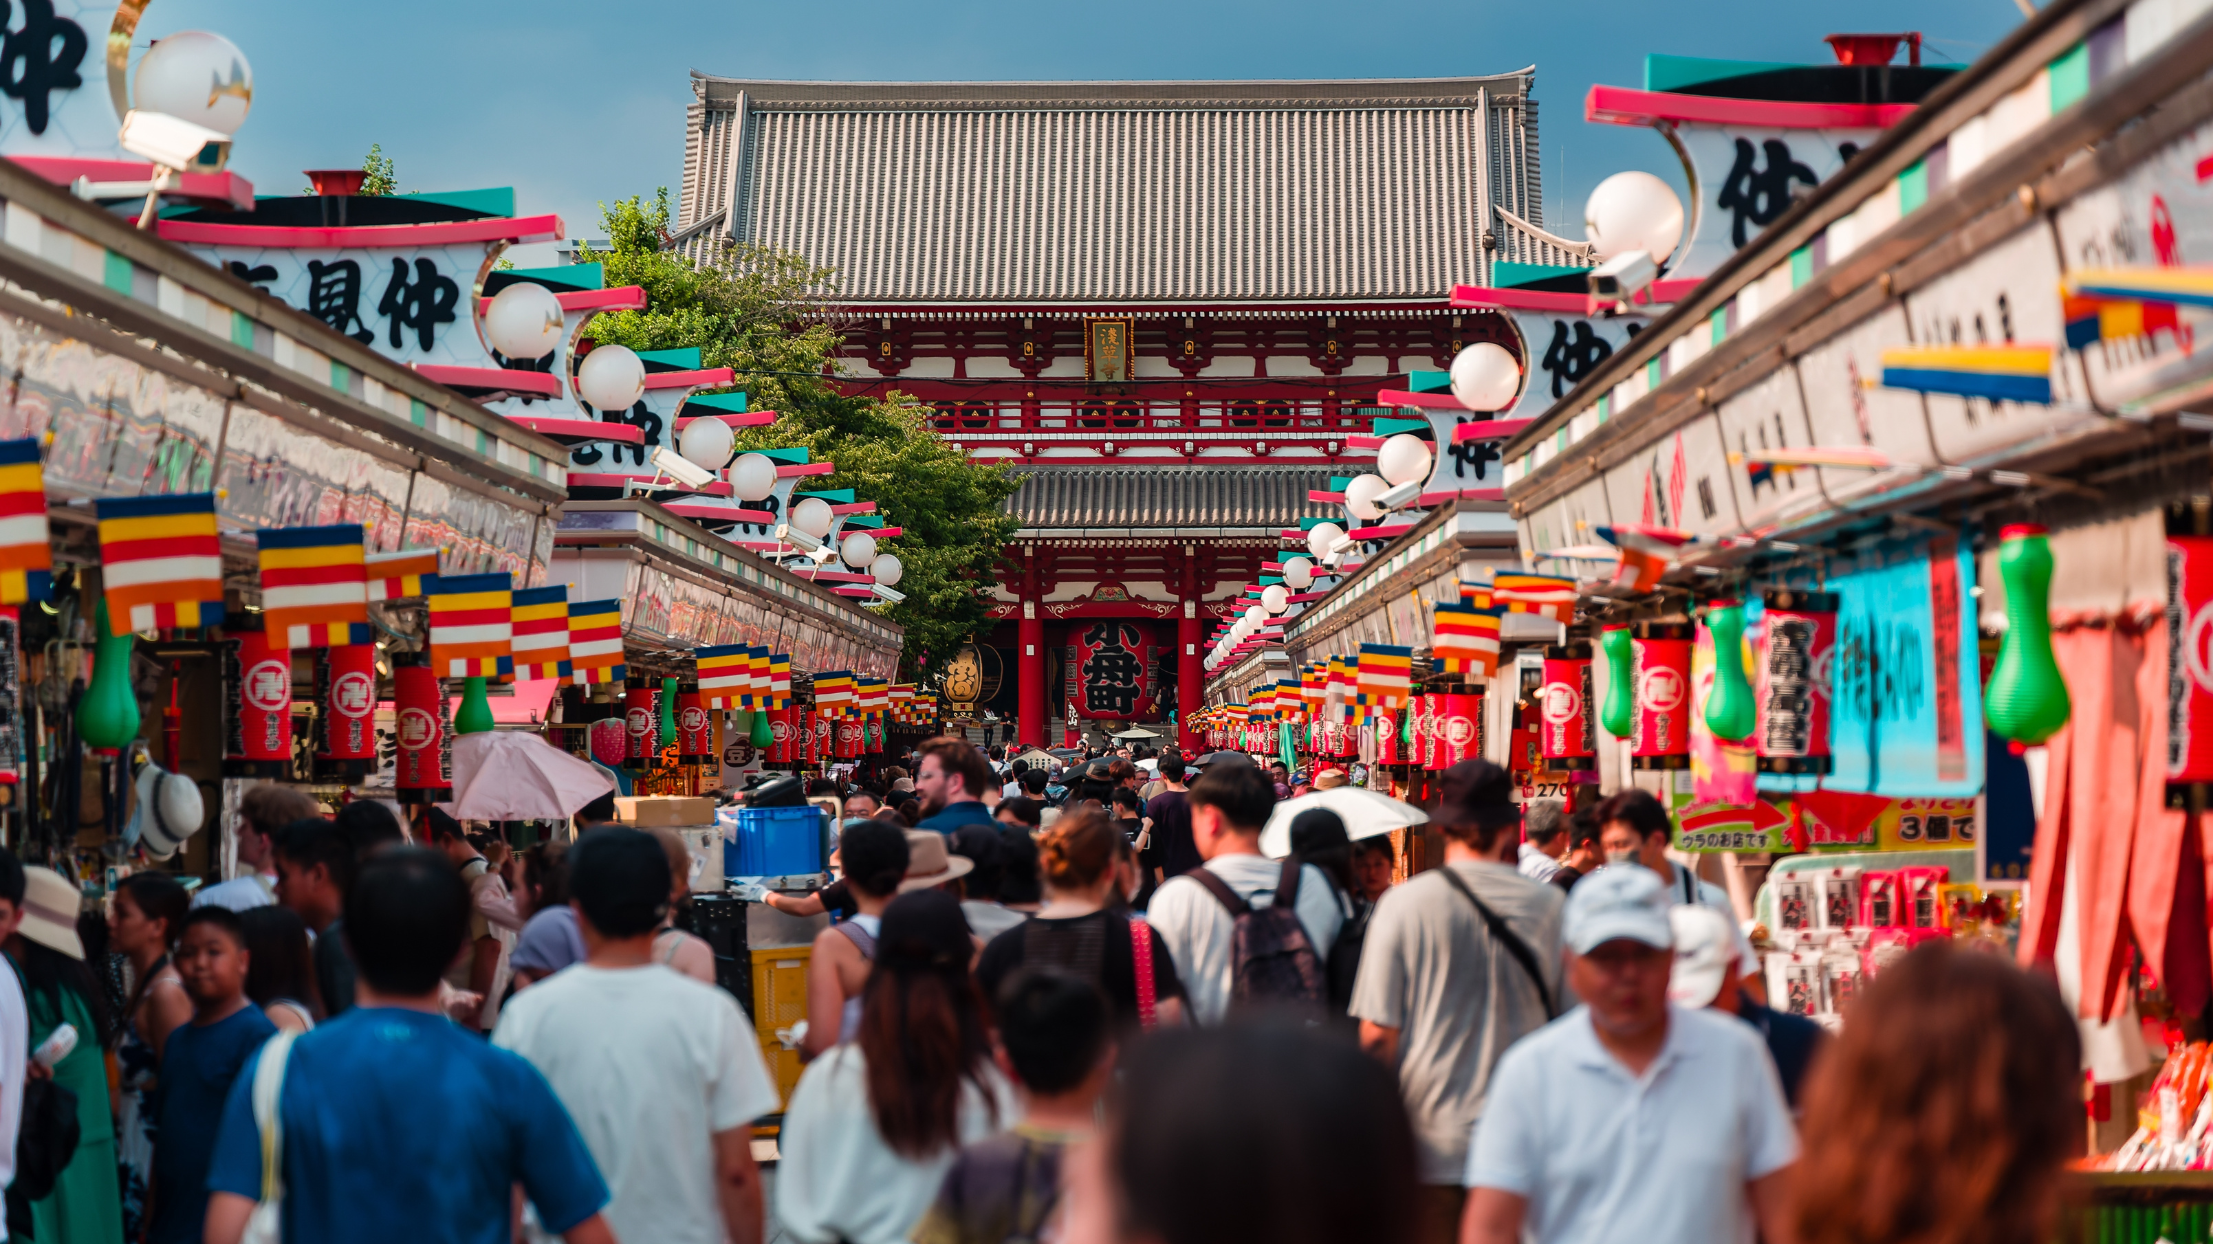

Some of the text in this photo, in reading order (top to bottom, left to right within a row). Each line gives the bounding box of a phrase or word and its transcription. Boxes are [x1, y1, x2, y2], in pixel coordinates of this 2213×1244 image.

[1718, 137, 1860, 249] 仲
[1542, 320, 1643, 398] 仲
[1682, 832, 1768, 848] ウラのお店です
[1900, 815, 1975, 841] 3個で
